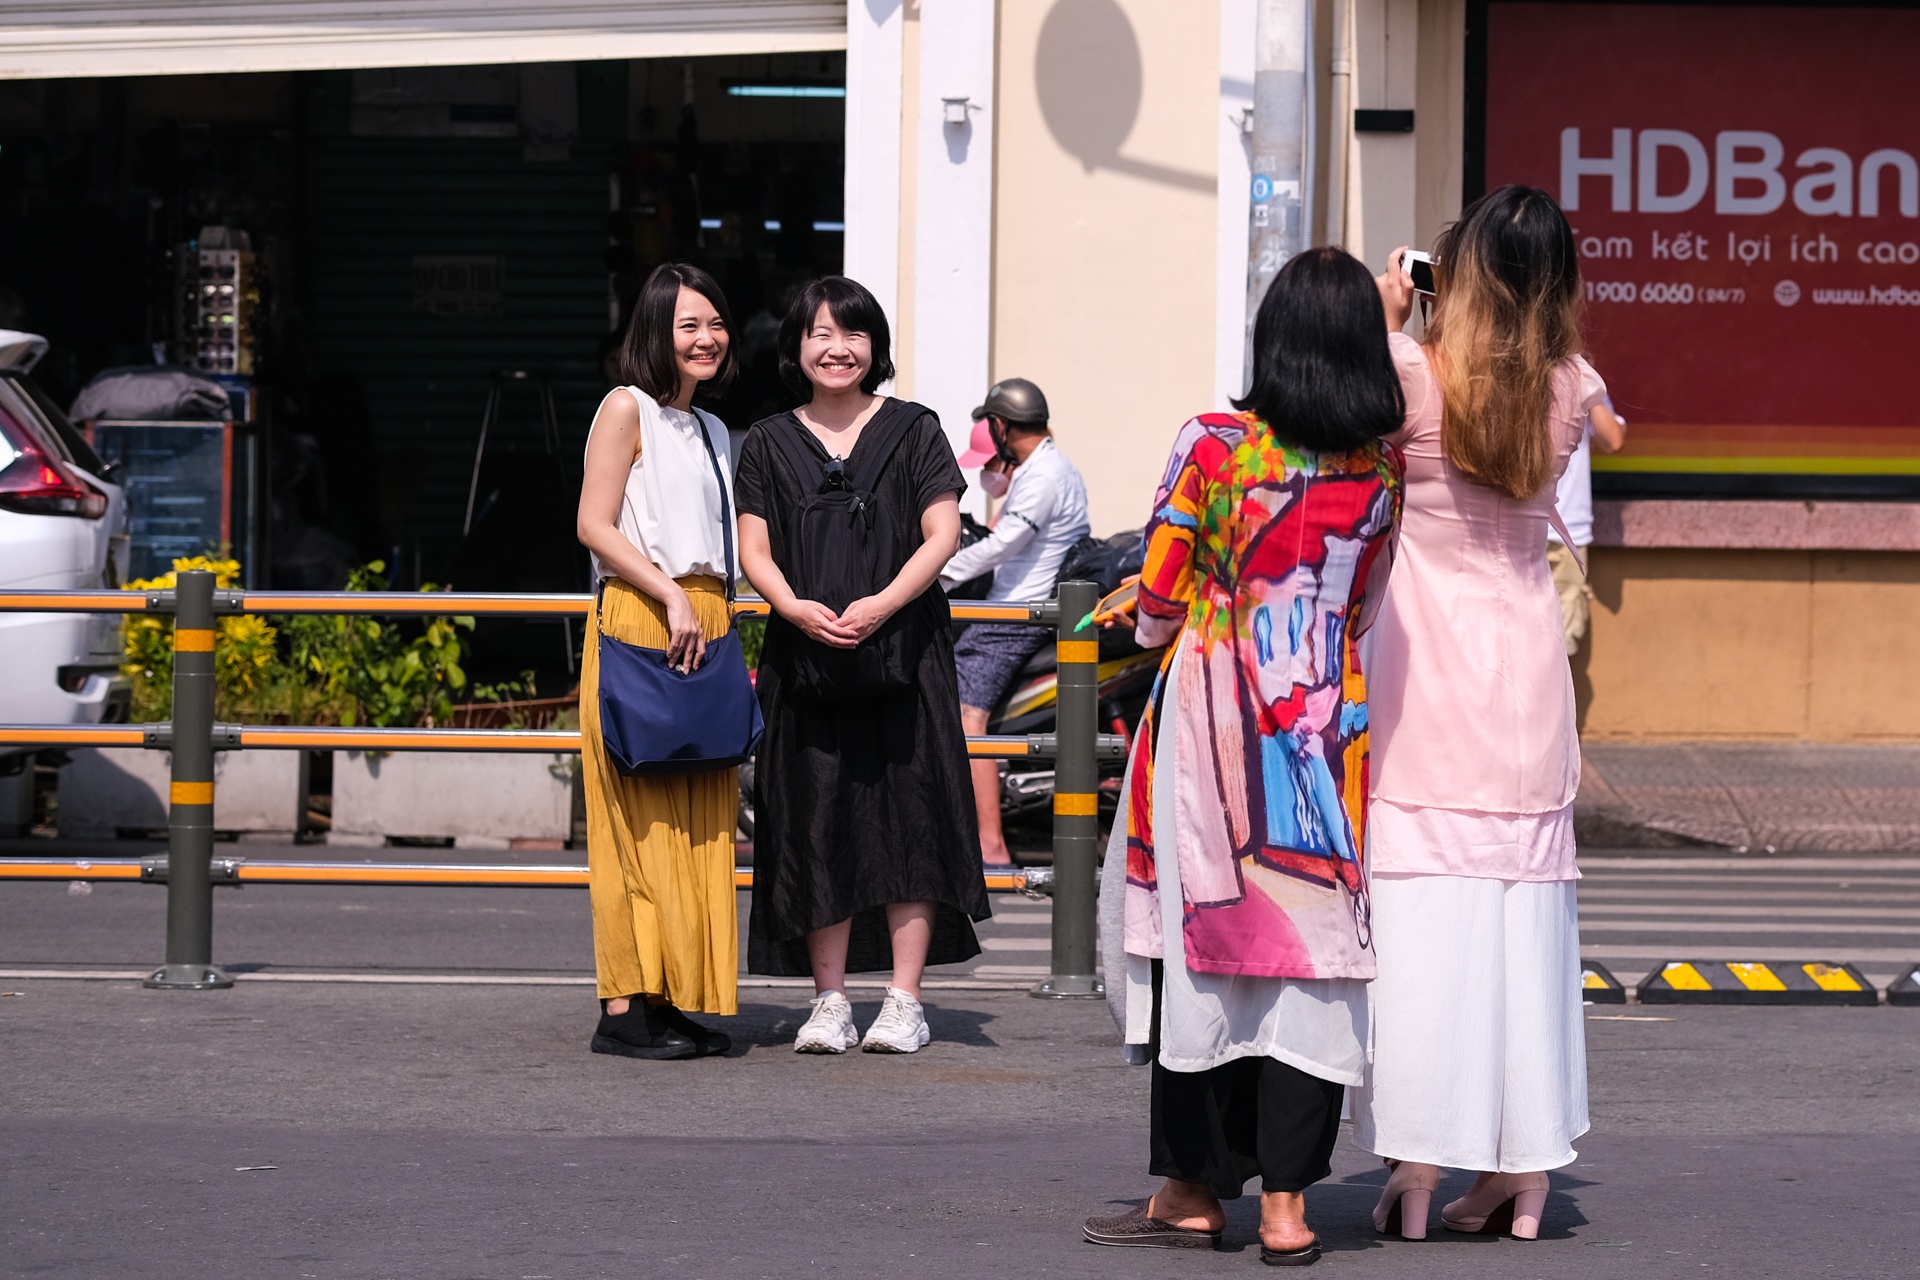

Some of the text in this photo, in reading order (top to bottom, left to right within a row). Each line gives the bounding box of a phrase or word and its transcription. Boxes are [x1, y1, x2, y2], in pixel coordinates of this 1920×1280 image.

[1560, 127, 1919, 218] HDBan
[1571, 228, 1920, 266] am kết lợi ích cao
[1586, 281, 1636, 304] 1900
[1641, 282, 1694, 304] 6060
